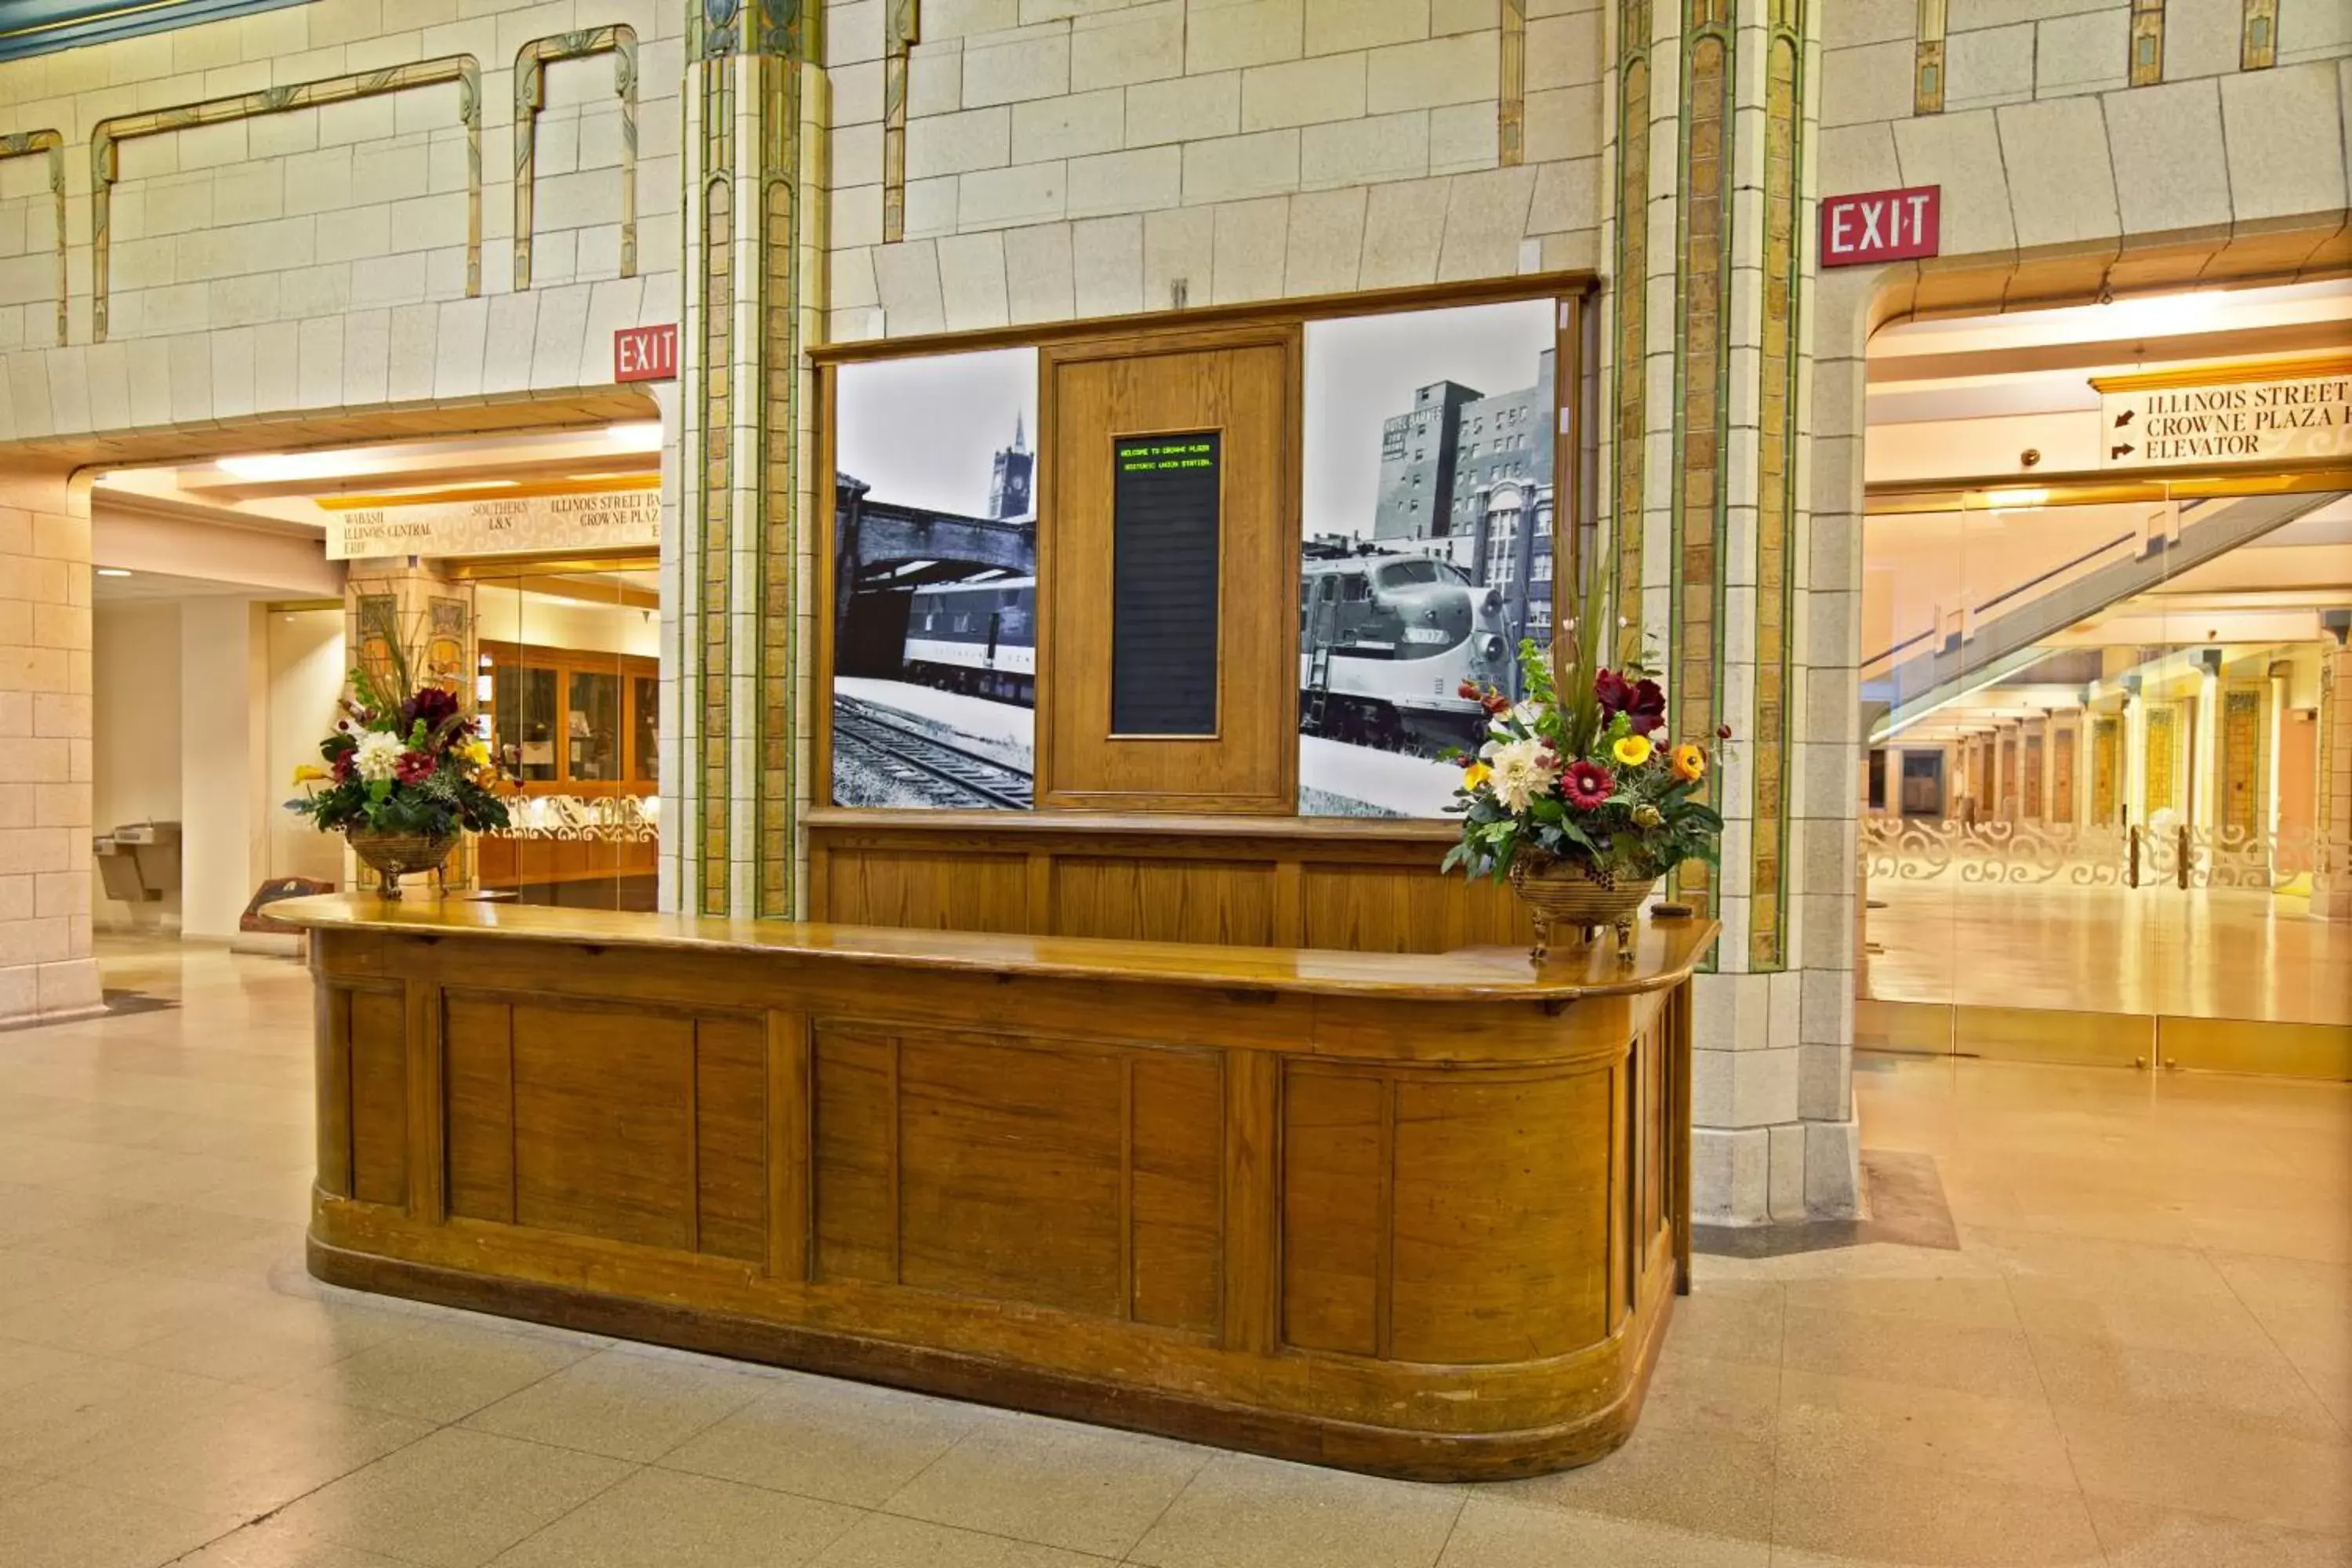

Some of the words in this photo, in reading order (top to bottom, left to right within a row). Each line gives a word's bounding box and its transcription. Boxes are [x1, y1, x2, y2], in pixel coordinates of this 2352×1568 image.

[1831, 194, 1930, 253] EXIT
[620, 330, 675, 372] EXIT
[2147, 390, 2247, 415] ILLINOIS
[2254, 381, 2349, 407] STREET
[2146, 412, 2246, 437] CROWNE
[2255, 407, 2332, 430] PLAZA
[2146, 435, 2259, 459] ELEVATOR
[470, 500, 530, 516] SOUTHERN
[551, 497, 597, 513] ILLINOIS
[601, 495, 641, 510] STREET
[343, 511, 384, 524] WABASH
[488, 517, 513, 531] L&N
[579, 510, 628, 527] CROWNE
[344, 525, 385, 540] ILLINOIS
[387, 522, 432, 539] CENTRAL
